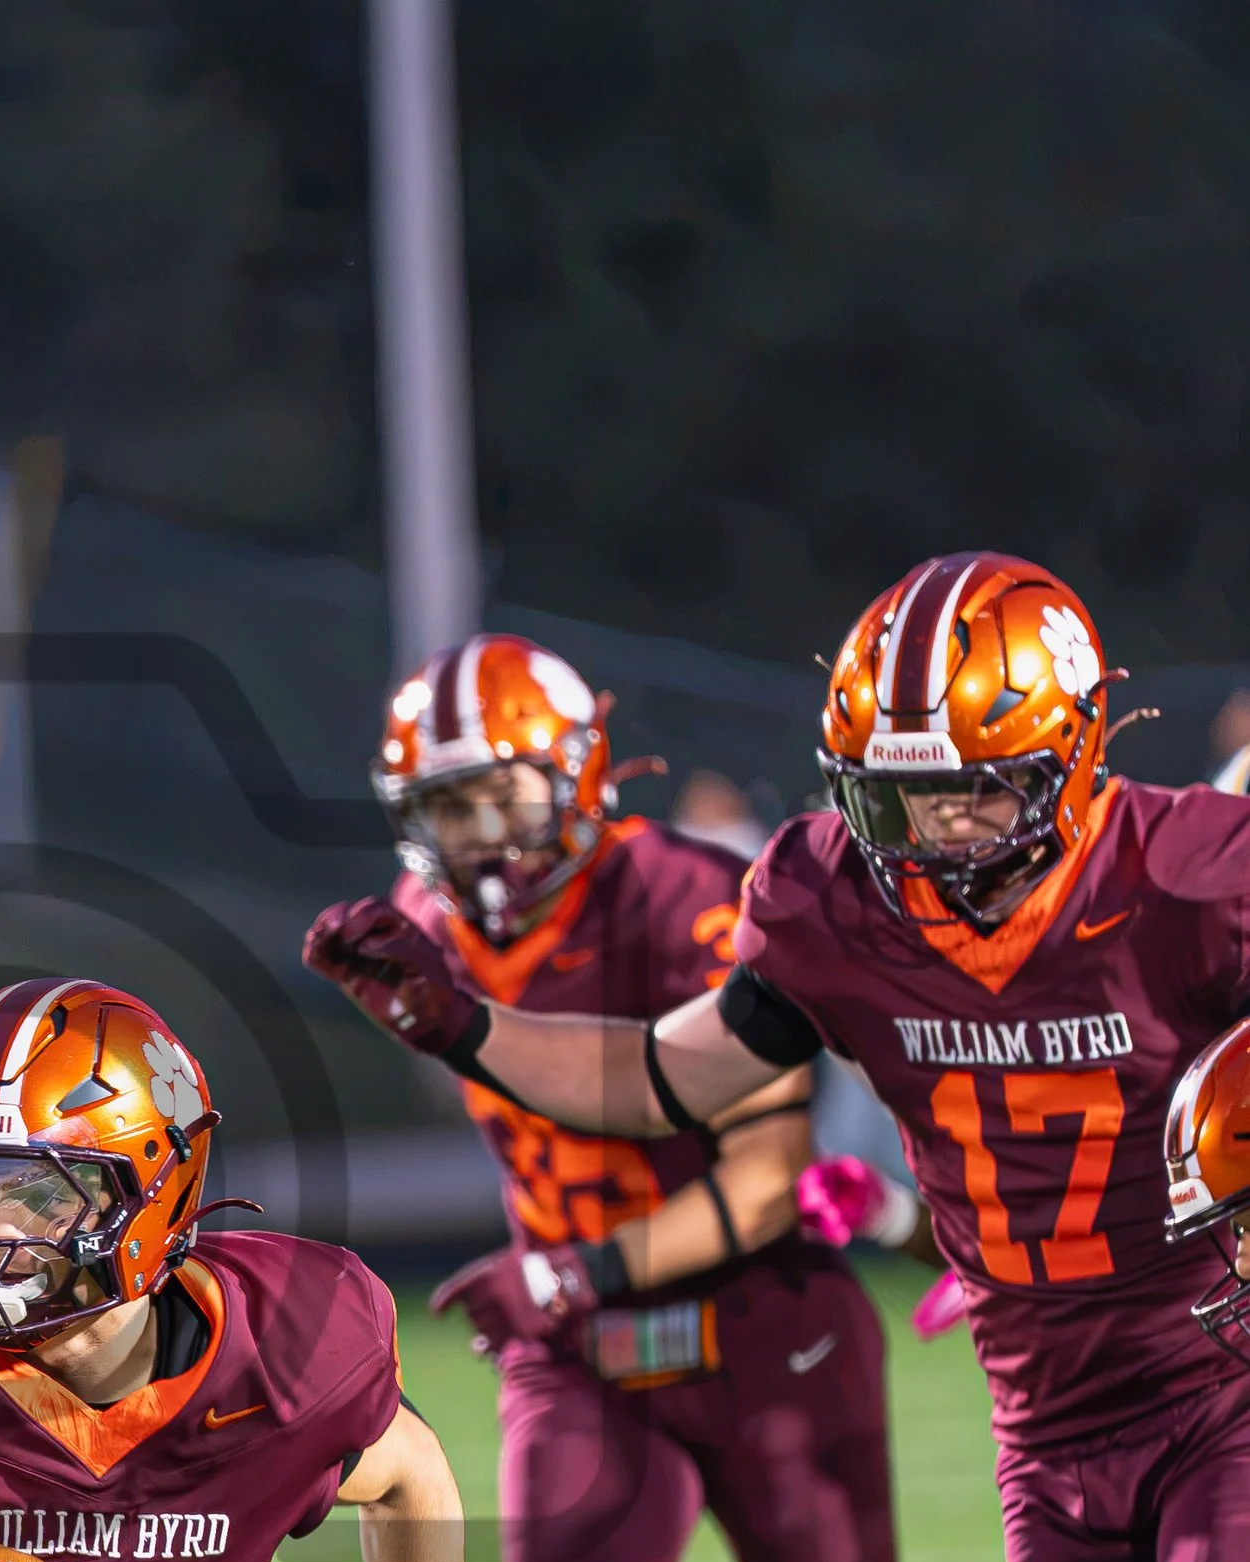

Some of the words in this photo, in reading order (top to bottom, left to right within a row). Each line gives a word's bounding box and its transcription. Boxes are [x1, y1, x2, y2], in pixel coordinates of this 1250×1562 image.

[872, 743, 945, 762] Riddell
[893, 1016, 1034, 1065] WILLIAM
[1038, 1011, 1134, 1064] BYRD
[931, 1067, 1126, 1287] 17
[133, 1513, 230, 1559] BYRD
